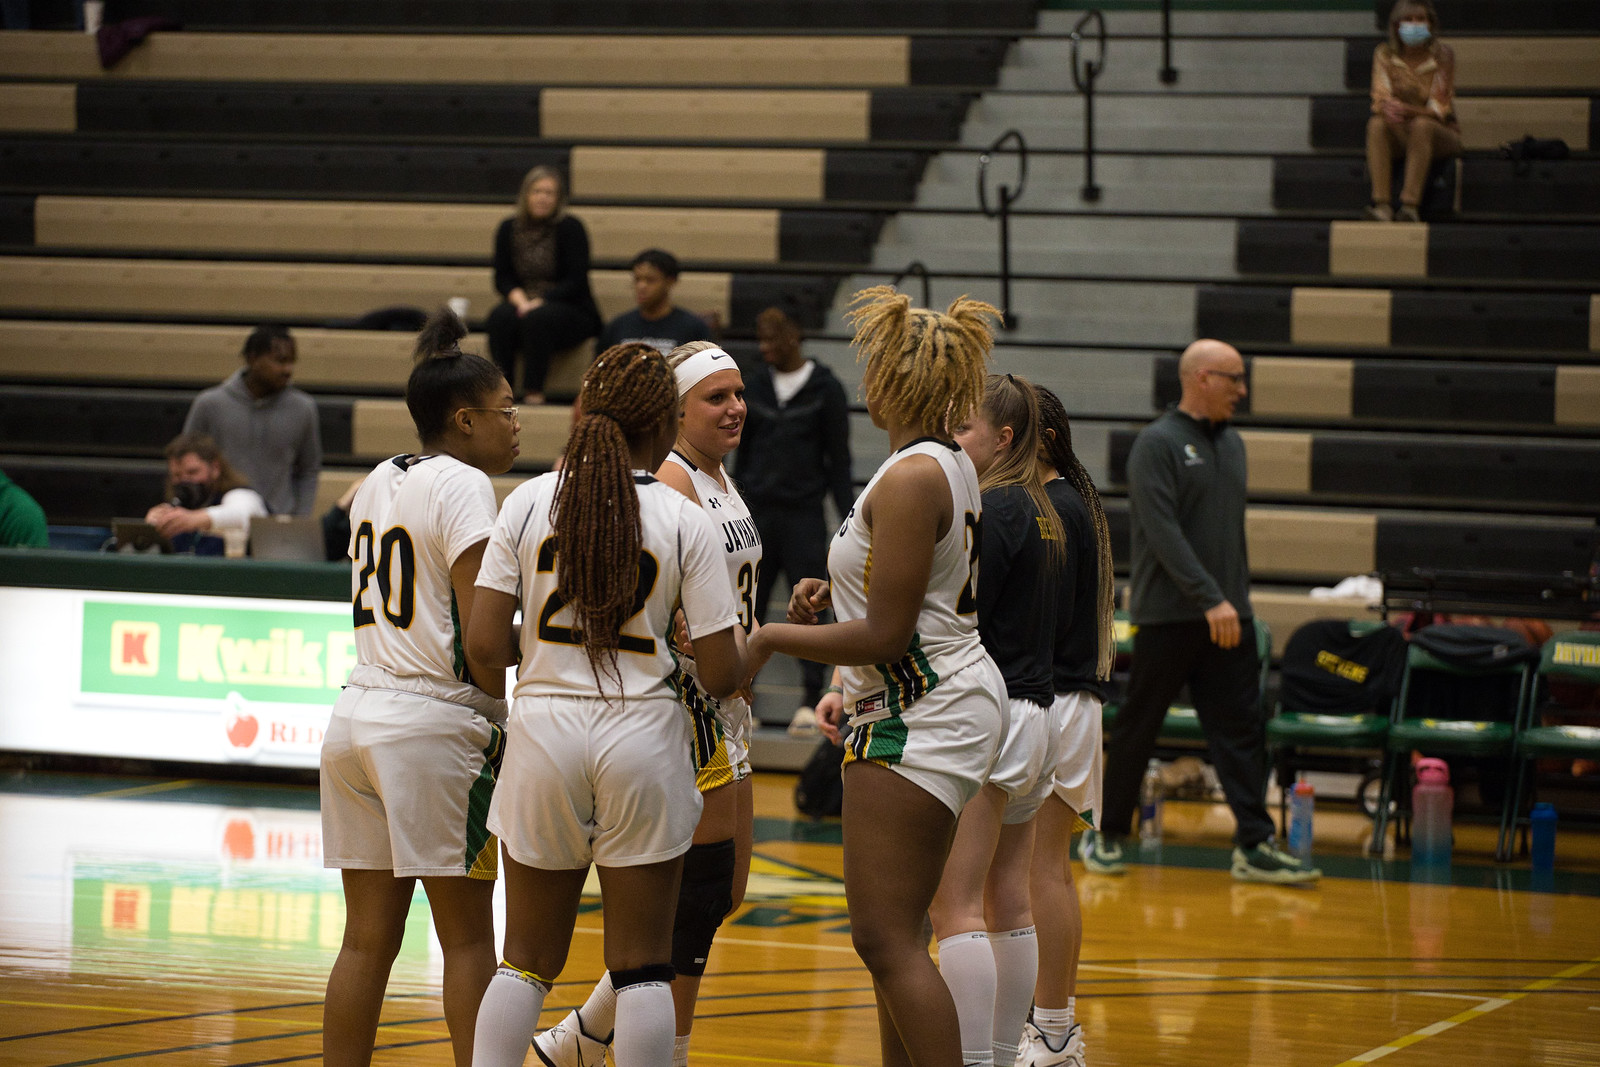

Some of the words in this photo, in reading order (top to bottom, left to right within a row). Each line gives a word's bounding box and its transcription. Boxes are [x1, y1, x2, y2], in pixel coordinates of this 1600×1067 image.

[352, 519, 416, 631] 20
[536, 534, 660, 656] 22
[122, 630, 149, 665] K
[178, 623, 324, 684] Kwik
[270, 720, 324, 744] RED
